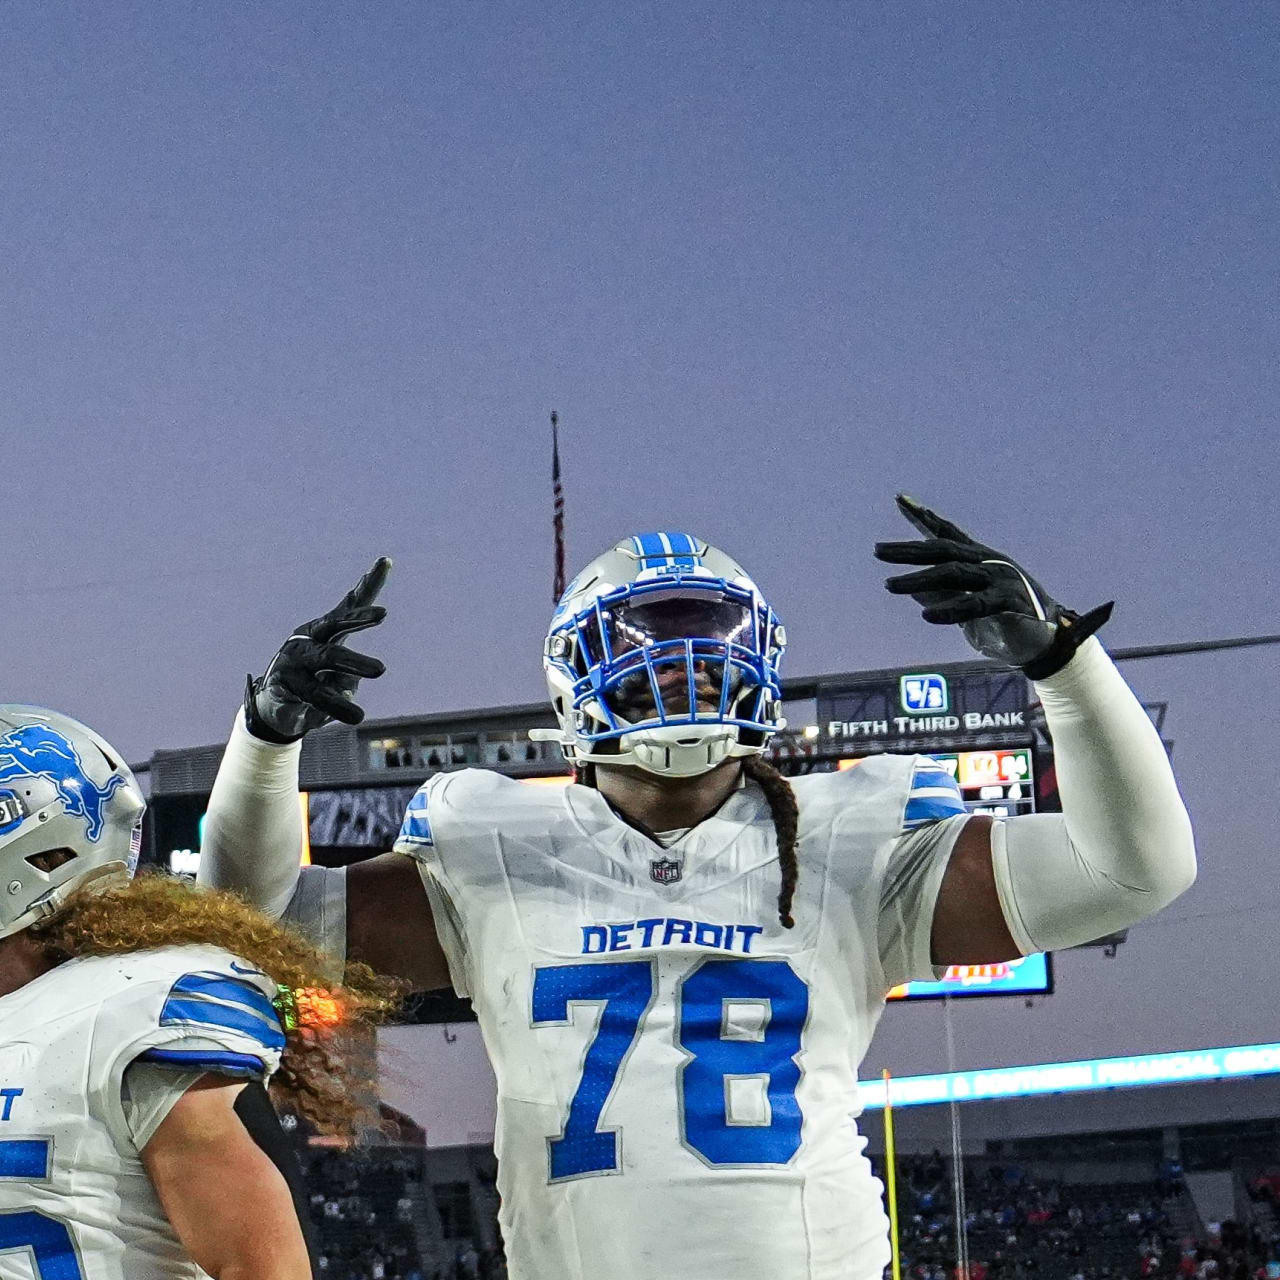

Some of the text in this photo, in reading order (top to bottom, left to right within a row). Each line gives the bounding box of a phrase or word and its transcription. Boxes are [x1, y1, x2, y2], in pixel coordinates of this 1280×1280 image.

[828, 711, 1025, 738] FIFTH THIRD BANK
[581, 918, 763, 954] DETROIT
[529, 954, 813, 1185] 78
